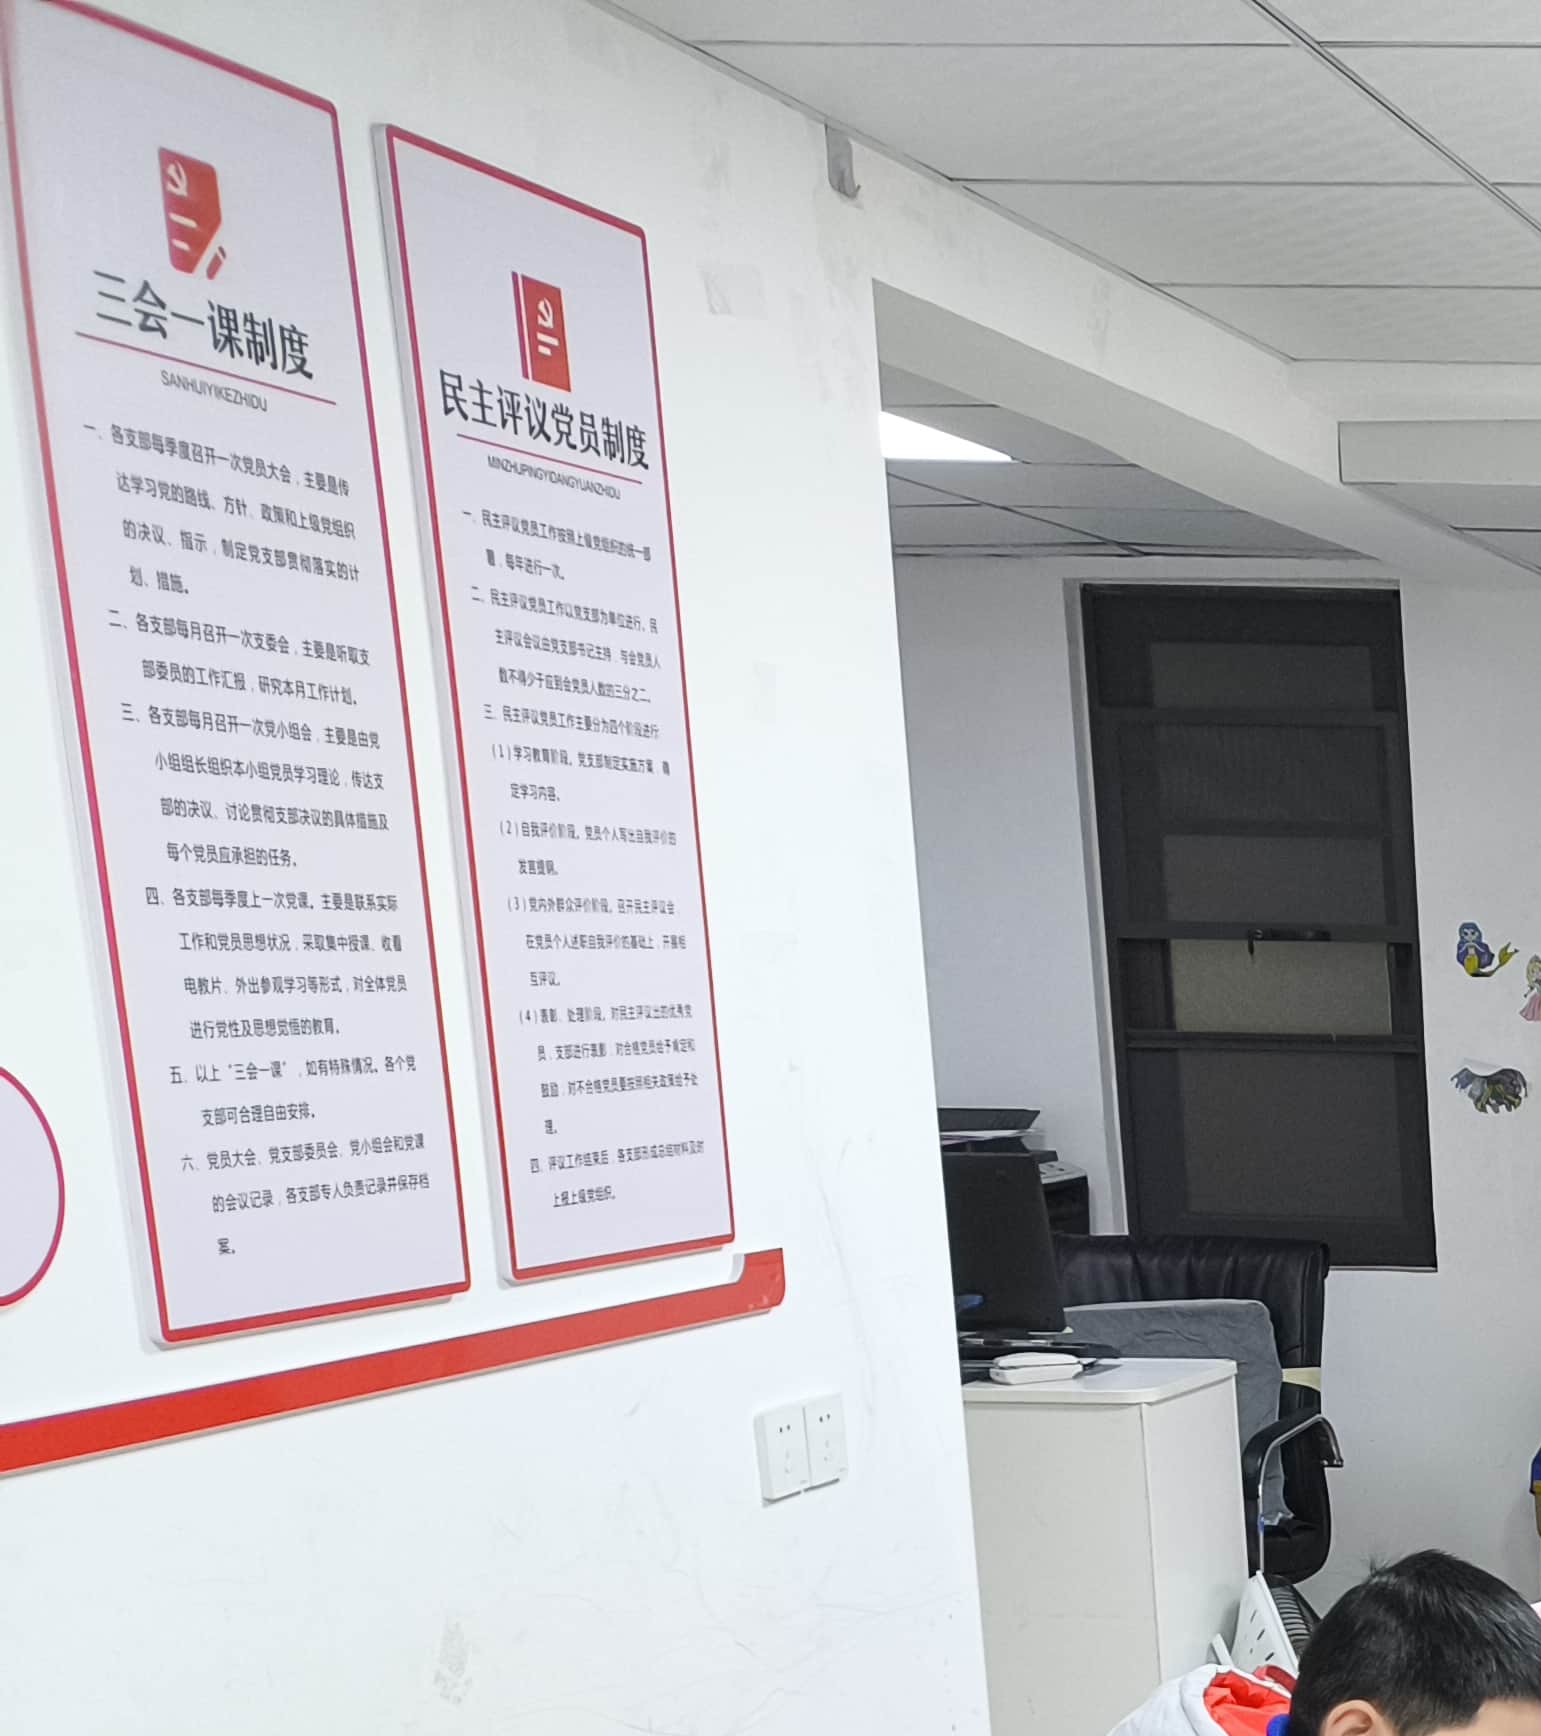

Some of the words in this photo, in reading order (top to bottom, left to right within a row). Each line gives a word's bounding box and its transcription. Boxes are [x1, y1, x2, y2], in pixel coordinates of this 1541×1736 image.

[93, 269, 314, 380] 三会一课制度
[160, 369, 268, 412] SANHUIYIKEZHIDU
[439, 368, 650, 471] 民主评议党员制度
